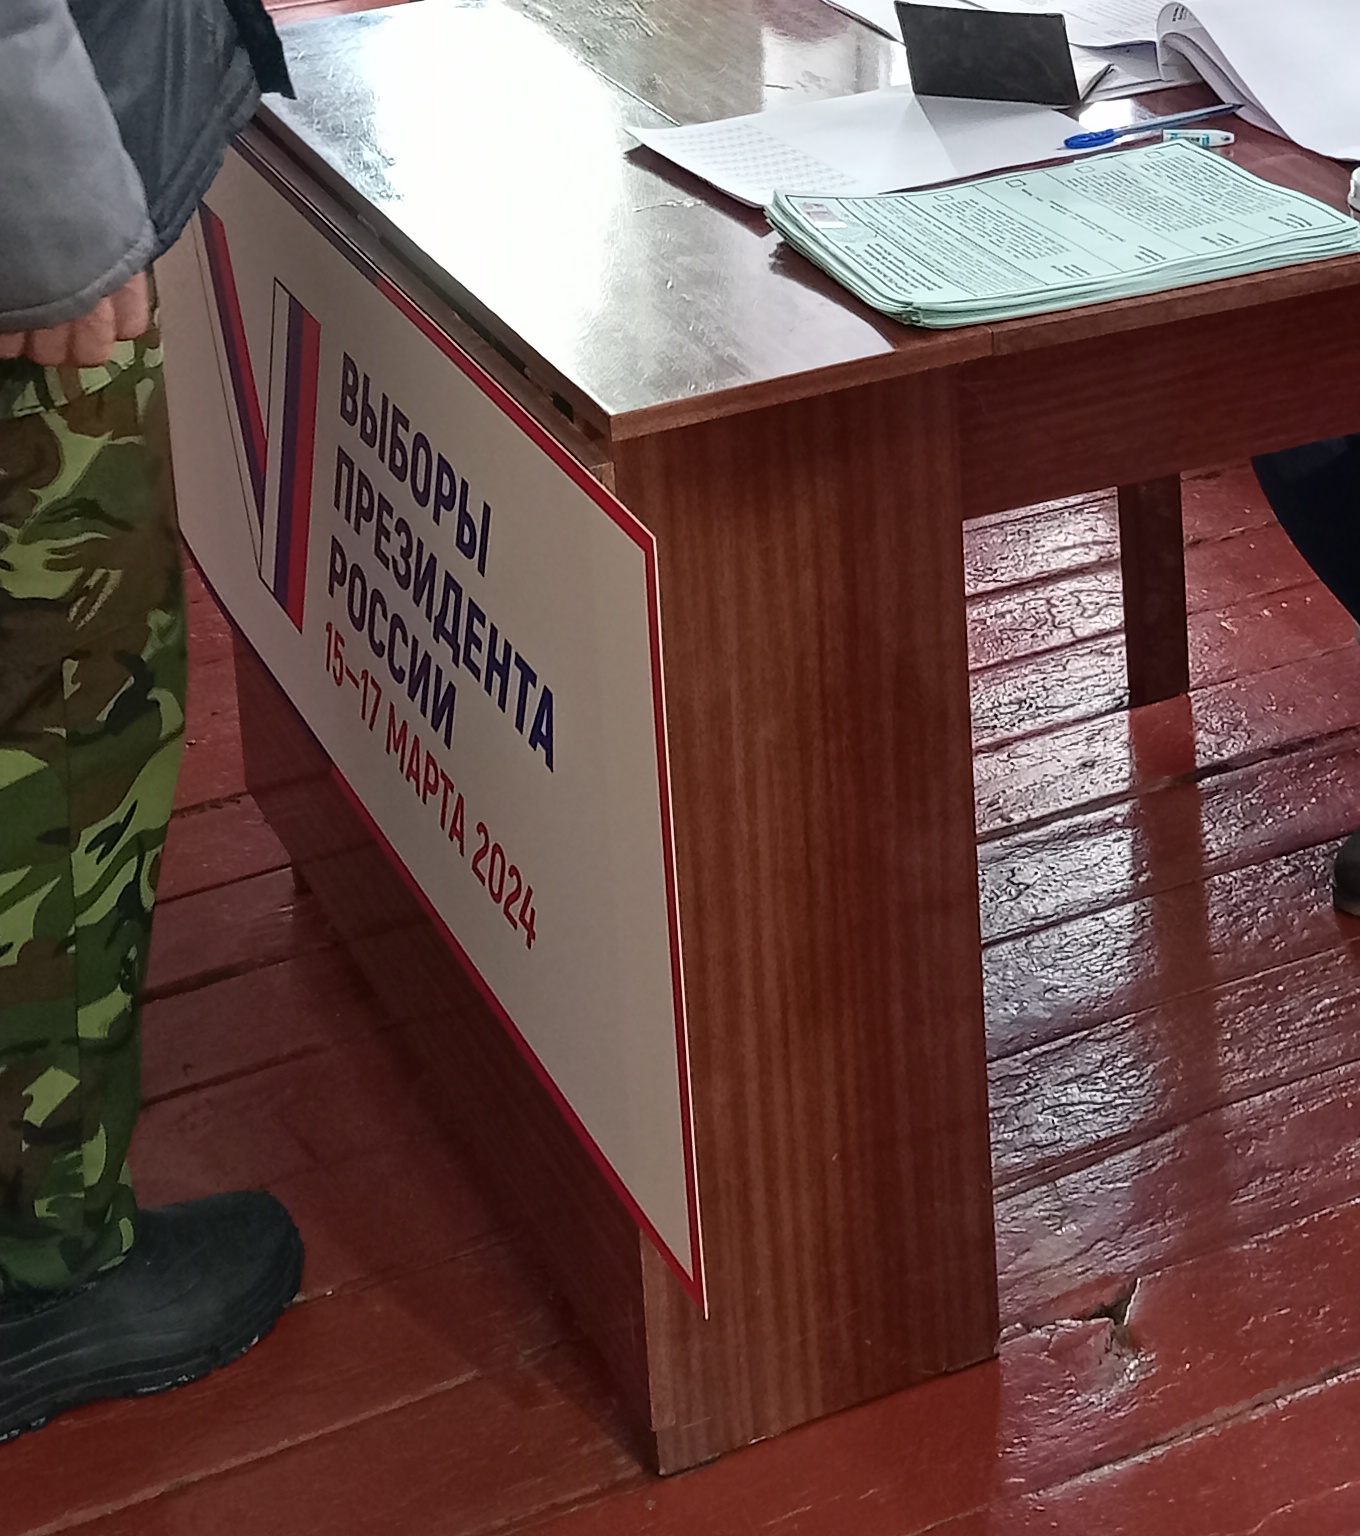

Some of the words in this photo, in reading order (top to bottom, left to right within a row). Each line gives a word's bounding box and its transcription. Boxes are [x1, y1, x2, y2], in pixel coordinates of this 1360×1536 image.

[340, 351, 492, 578] ВЫБОРЫ
[329, 534, 458, 751] РОССИИ
[333, 445, 555, 773] ПРЕЗИДЕНТА
[386, 701, 466, 857] МАРТА
[472, 821, 537, 951] 2024
